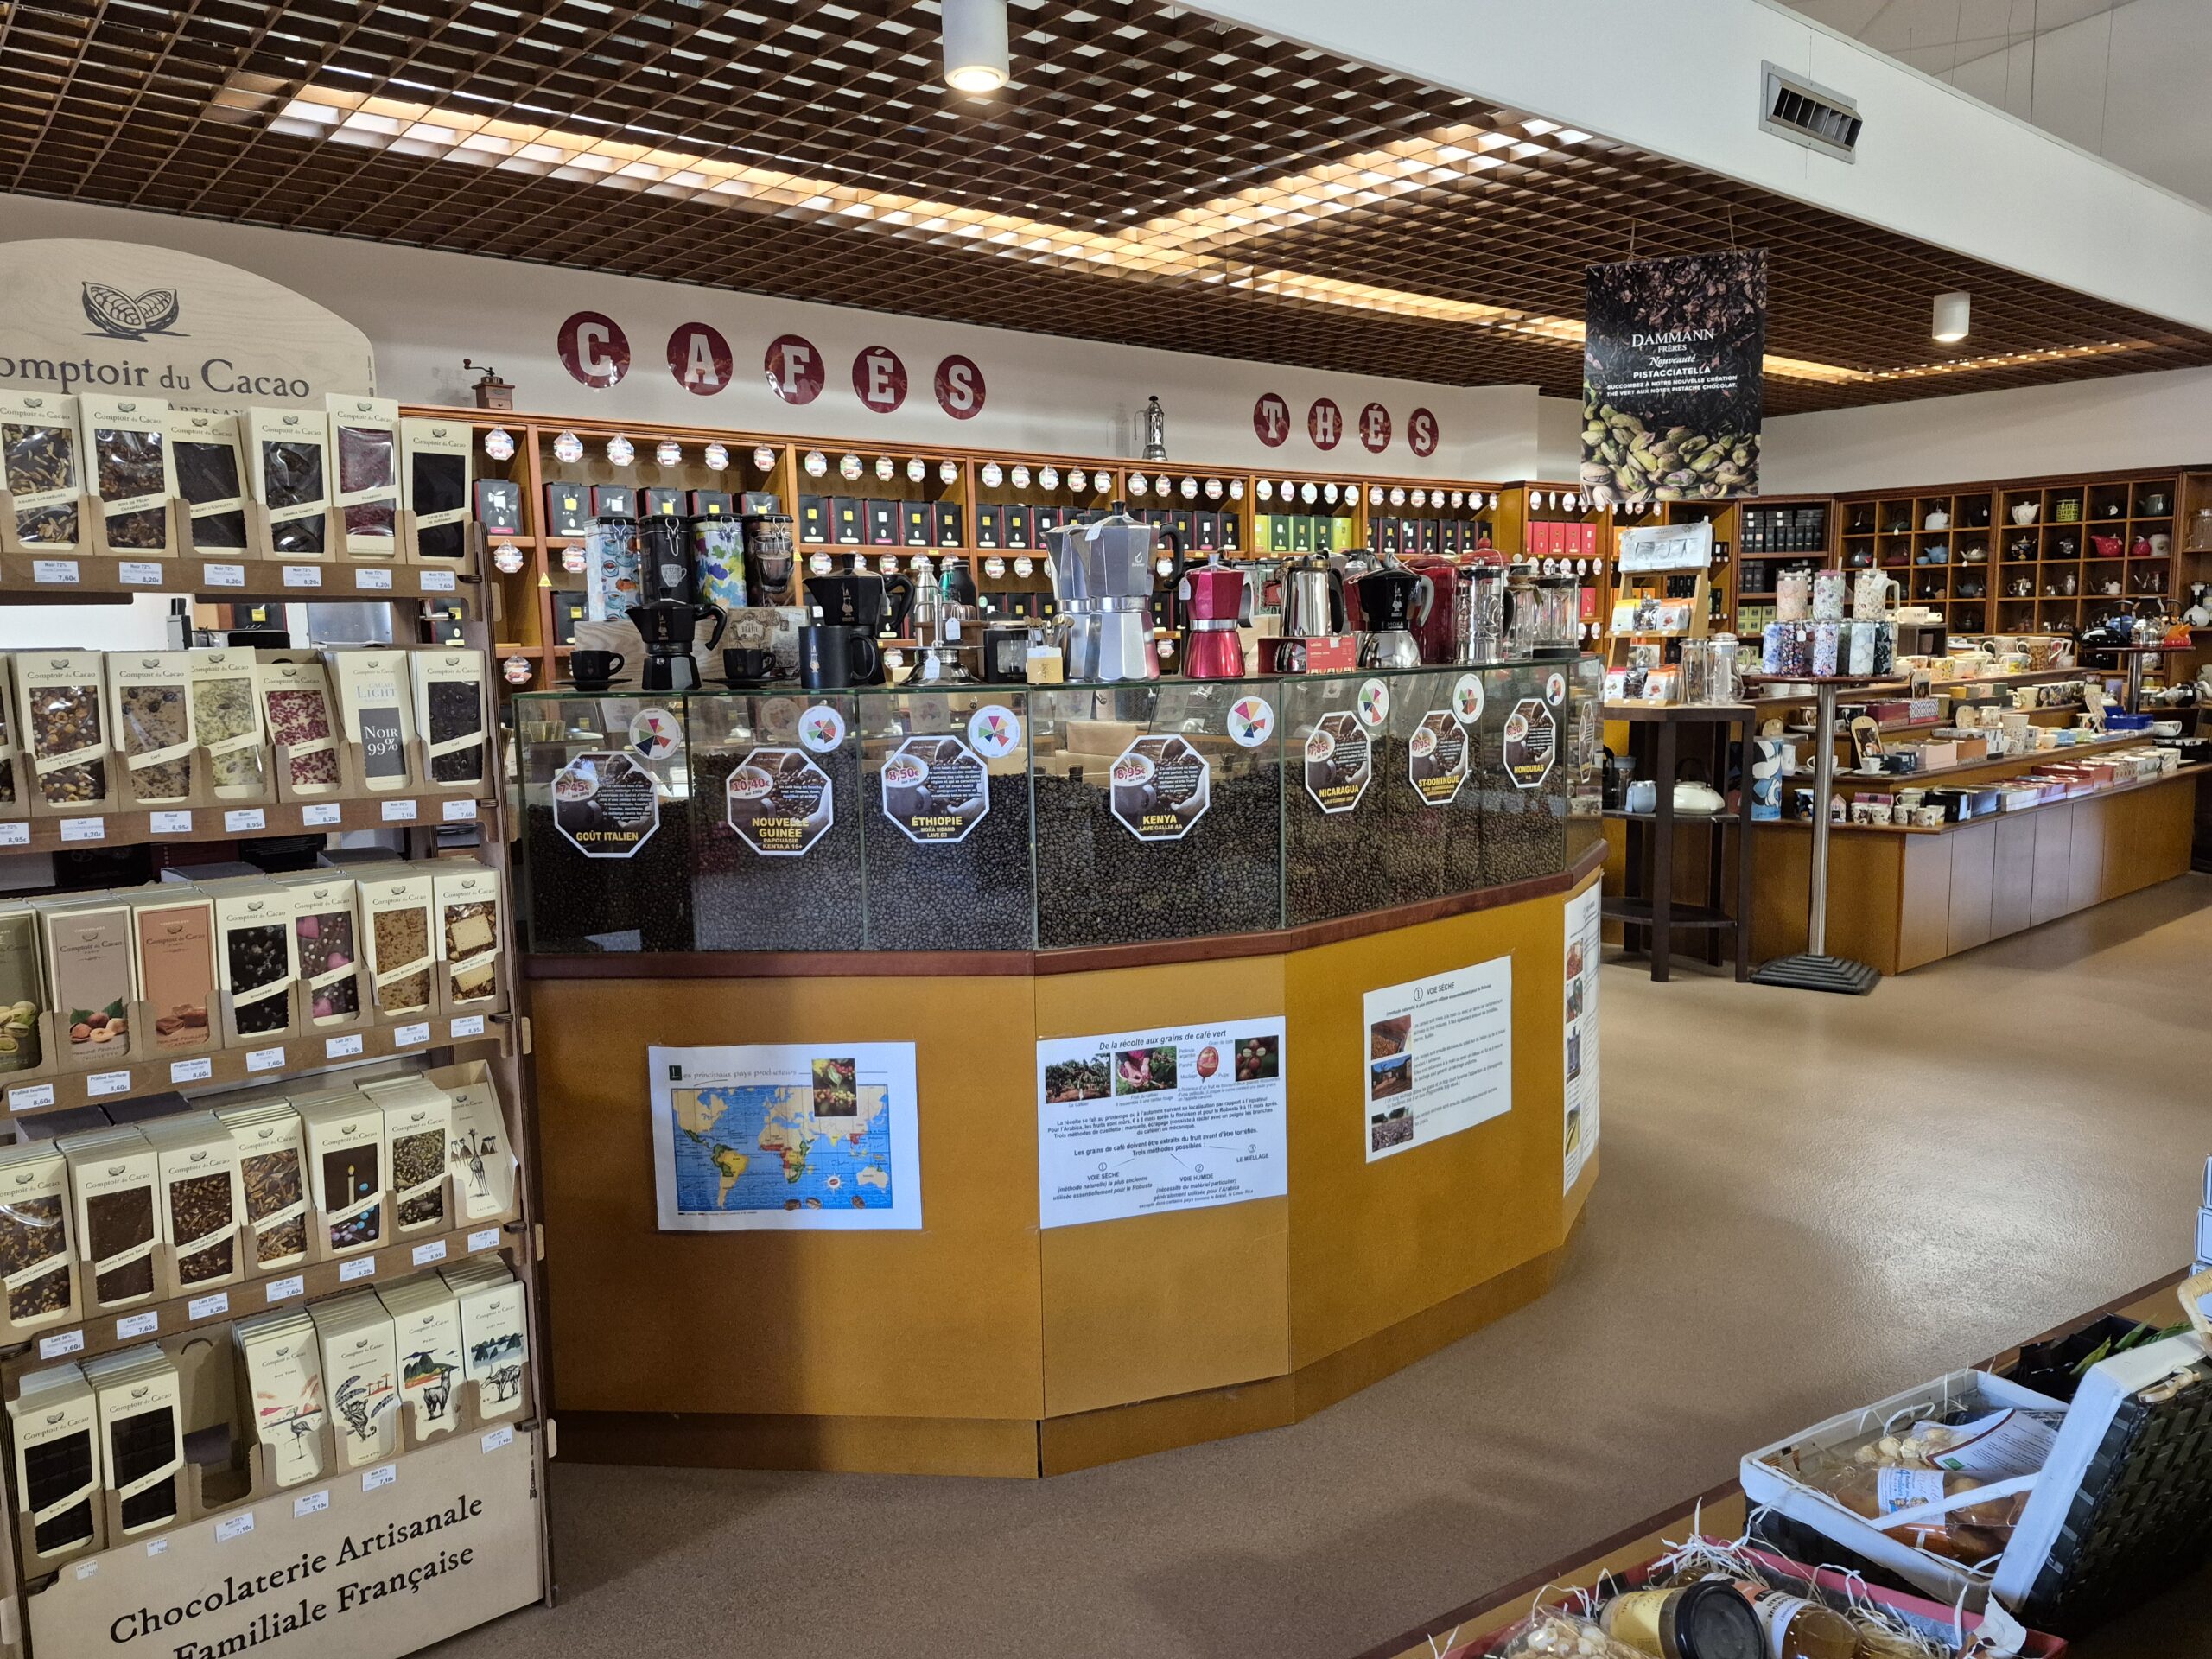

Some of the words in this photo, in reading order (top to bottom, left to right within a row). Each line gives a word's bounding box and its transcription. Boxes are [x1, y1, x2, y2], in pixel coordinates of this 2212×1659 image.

[1631, 328, 1715, 347] DAMMANN
[1657, 344, 1688, 353] FRÈRES
[576, 321, 974, 410] CAFÉS
[1649, 353, 1697, 367] Nouveauté
[1633, 365, 1712, 378] PISTACCIATELLA
[160, 365, 192, 390] du
[200, 359, 311, 398] Cacao
[0, 408, 37, 421] Comptoir
[47, 411, 70, 421] Cacao
[94, 411, 130, 424] Comptoir
[139, 415, 162, 424] Cacao
[1262, 400, 1431, 450] THÉS
[27, 671, 63, 683] Comptoir
[73, 670, 96, 678] Cacao
[119, 670, 154, 681] Comptoir
[364, 726, 398, 739] NOIR
[367, 737, 398, 755] 99%
[887, 767, 919, 781] 8,50€
[1116, 766, 1146, 779] 8,95€
[1514, 764, 1544, 774] HONDURAS
[732, 778, 770, 791] 10,40€
[1418, 774, 1459, 787] ST-DOMINGUE
[1319, 785, 1359, 798] NICARAGUA
[752, 817, 810, 827] NOUVELLE
[912, 816, 963, 826] ÉTHIOPIE
[1143, 815, 1178, 824] KENYA
[576, 830, 601, 842] GOÛT
[603, 831, 639, 842] ITALIEN
[759, 826, 803, 837] GUINÉE
[226, 912, 258, 922] Comptoir
[1427, 985, 1438, 995] VOIE
[1099, 1041, 1109, 1051] De
[1111, 1039, 1117, 1049] la
[1119, 1036, 1144, 1048] récolte
[1146, 1036, 1159, 1045] aux
[1160, 1033, 1183, 1046] grains
[1185, 1032, 1194, 1041] de
[1196, 1030, 1211, 1039] café
[1212, 1029, 1226, 1038] vert
[734, 1071, 751, 1079] pays
[754, 1068, 797, 1079] producteurs
[1086, 1147, 1103, 1156] grains
[1114, 1143, 1125, 1153] café
[1126, 1141, 1147, 1150] doivent
[1160, 1136, 1180, 1145] extraits
[1190, 1133, 1202, 1141] fruit
[1218, 1129, 1234, 1138] d'être
[1235, 1127, 1258, 1136] torréfiés.
[1148, 1145, 1174, 1154] méthodes
[1175, 1142, 1202, 1153] possibles
[1245, 1153, 1269, 1162] MIELLAGE
[85, 1178, 120, 1190] Comptoir
[129, 1173, 150, 1182] Cacao
[1114, 1178, 1125, 1188] plus
[1126, 1176, 1148, 1185] ancienne
[1113, 1186, 1125, 1195] pour
[1132, 1182, 1153, 1191] Robusta
[138, 1325, 156, 1333] 7,60€
[63, 1344, 81, 1352] 7,60€
[110, 1400, 143, 1414] Comptoir
[151, 1392, 172, 1402] Cacao
[23, 1427, 59, 1440] Comptoir
[67, 1415, 89, 1427] Cacao
[110, 1554, 327, 1643] Chocolaterie
[335, 1495, 483, 1566] Artisanale
[174, 1599, 327, 1659] Familiale
[337, 1548, 474, 1614] Française
